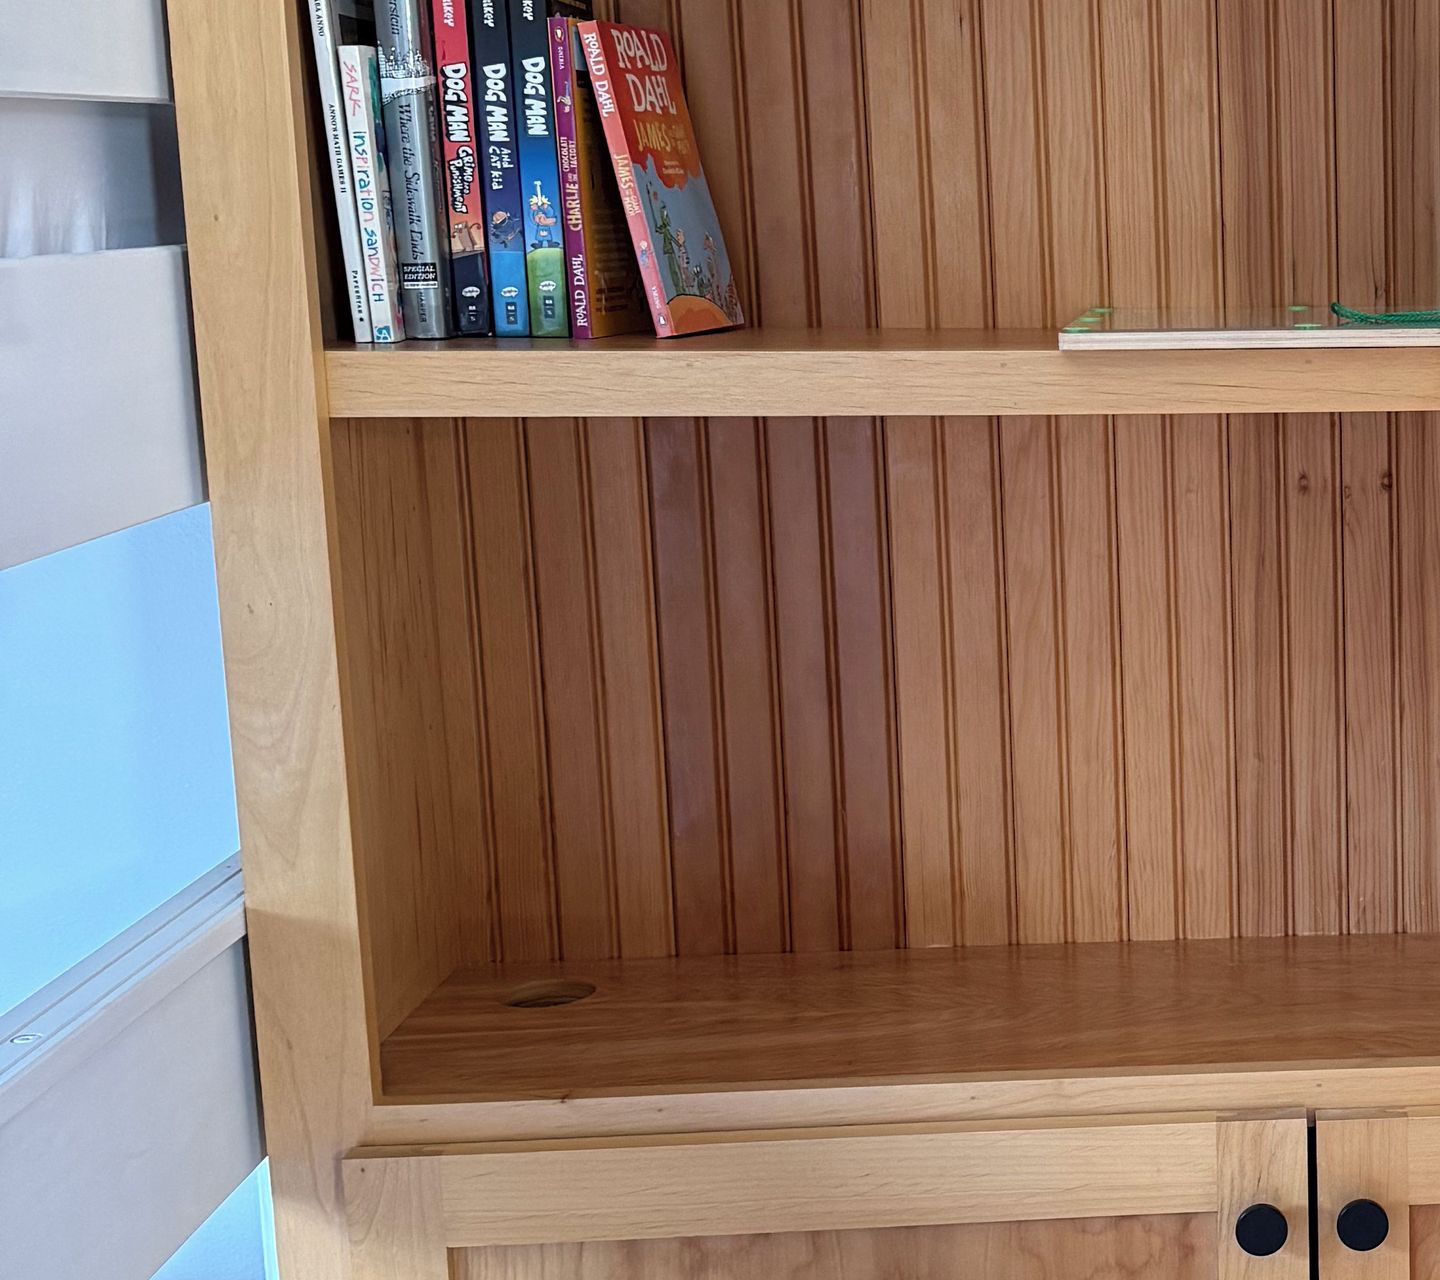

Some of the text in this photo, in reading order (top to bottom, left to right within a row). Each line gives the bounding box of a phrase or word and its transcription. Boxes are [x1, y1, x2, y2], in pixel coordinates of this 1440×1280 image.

[583, 32, 615, 117] ROALD DAHL
[611, 29, 667, 72] ROALD
[343, 61, 361, 117] SARK
[442, 62, 471, 142] DOG MAN
[483, 62, 510, 142] DOG MAN
[521, 56, 549, 136] DOG MAN
[625, 73, 677, 115] DAHL
[489, 146, 501, 169] CAT
[633, 119, 671, 152] JAMES
[352, 130, 376, 223] Inspiration
[398, 102, 425, 261] Where the Sidewalk Ends
[614, 154, 634, 189] JAMES
[566, 182, 583, 231] CHARLIE
[572, 254, 588, 327] ROALD DAHL
